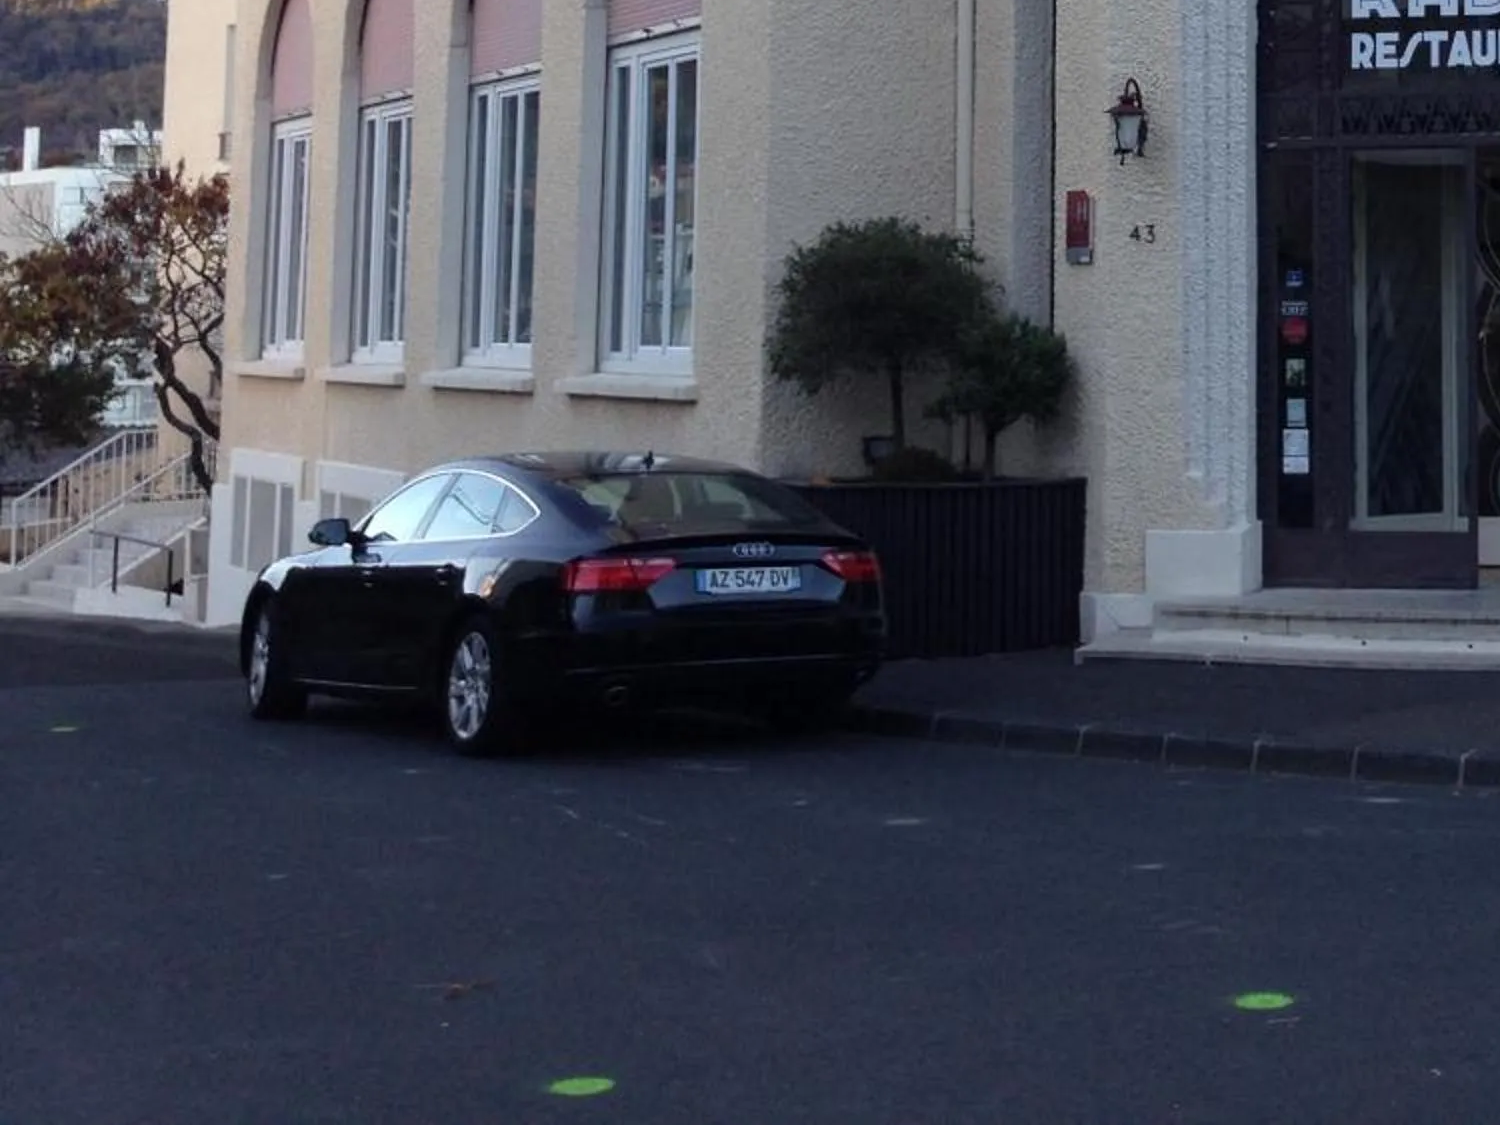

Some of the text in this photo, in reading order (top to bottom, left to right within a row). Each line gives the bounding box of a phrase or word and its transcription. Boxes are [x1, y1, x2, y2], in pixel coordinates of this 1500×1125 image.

[1129, 224, 1155, 243] 43
[710, 570, 730, 588] AZ
[735, 570, 764, 588] 547
